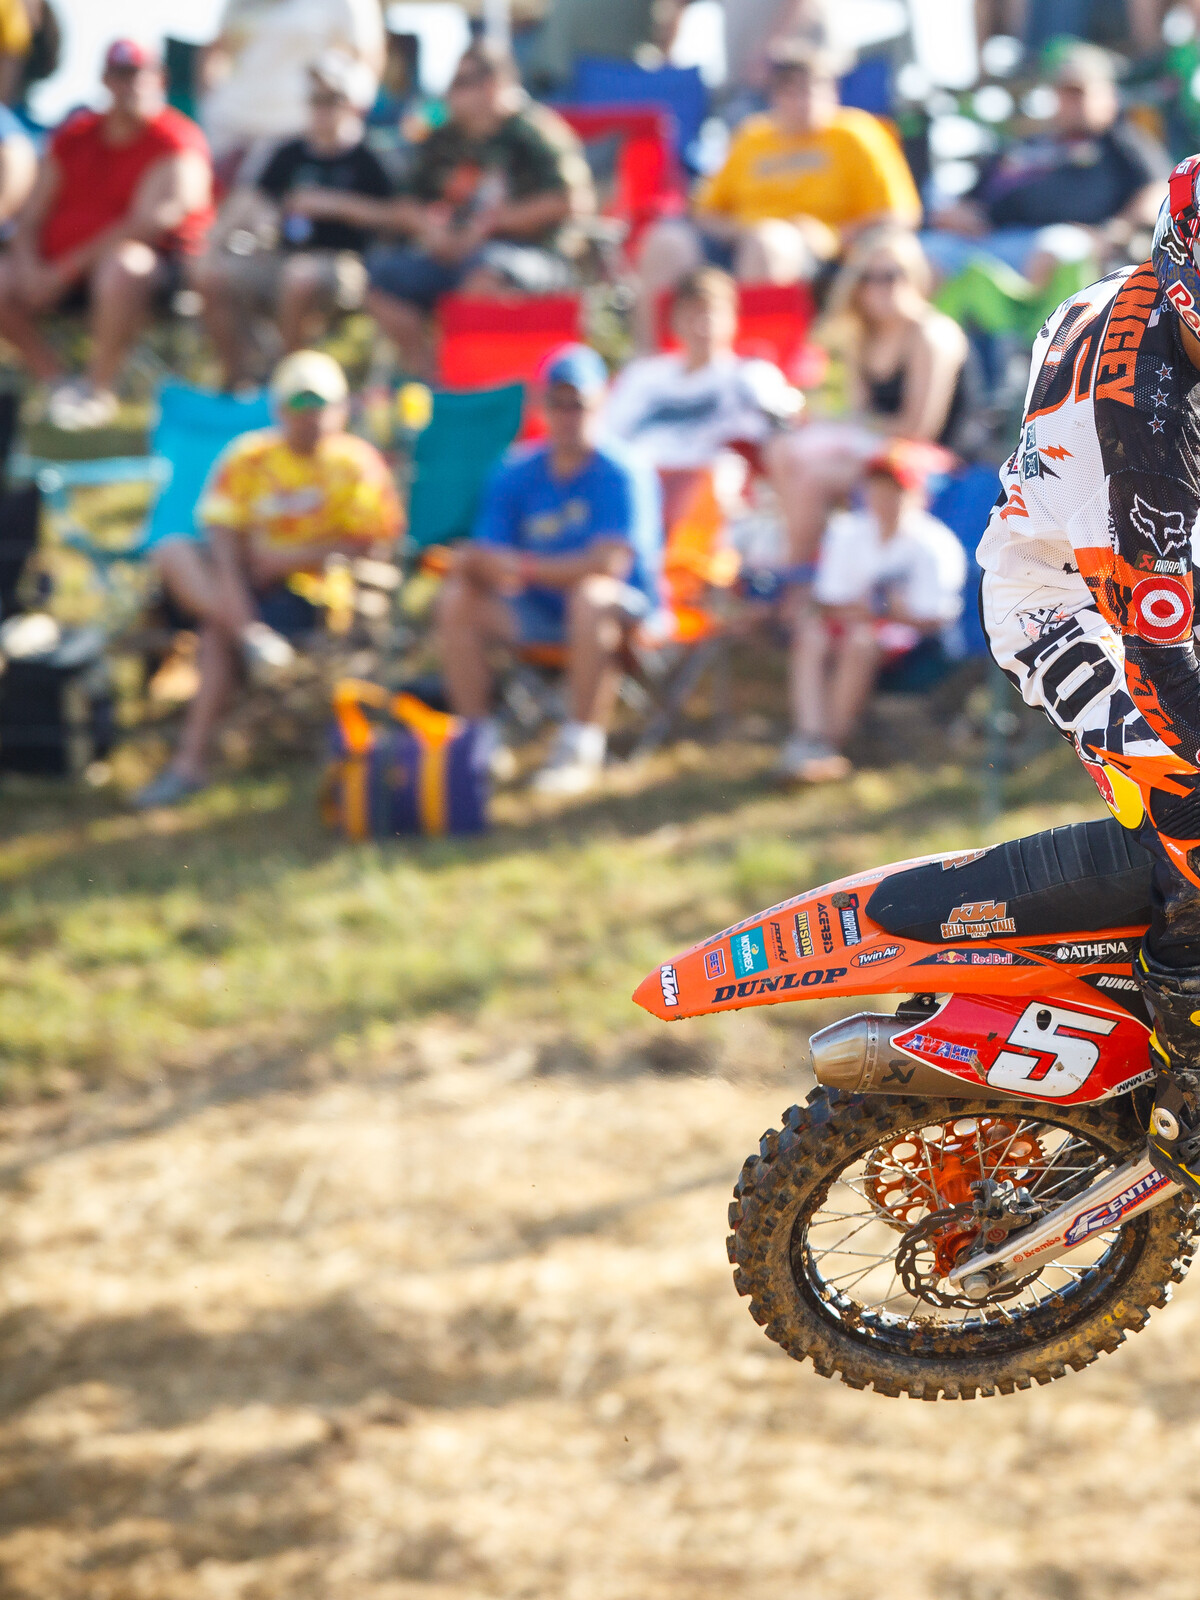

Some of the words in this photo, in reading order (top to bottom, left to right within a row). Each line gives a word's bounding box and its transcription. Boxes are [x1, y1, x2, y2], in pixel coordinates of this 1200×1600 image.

[1096, 257, 1159, 408] UNGEY
[1166, 842, 1184, 857] FOX
[948, 900, 1007, 924] KTM
[798, 912, 813, 956] HINSON
[941, 922, 965, 939] SELLE
[966, 923, 991, 936] DALLA
[991, 917, 1016, 932] VALLE
[740, 934, 754, 972] MOTOREX
[859, 949, 881, 965] Twin
[884, 945, 899, 957] Air
[971, 953, 992, 964] Red
[993, 954, 1012, 965] Bull
[1070, 942, 1128, 959] ATHENA
[709, 953, 720, 974] GET
[660, 964, 679, 1007] KTM
[711, 967, 847, 1003] DUNLOP
[903, 1033, 951, 1058] AMA
[951, 1044, 978, 1058] PRO
[986, 1001, 1120, 1098] 5
[1024, 1236, 1061, 1258] brembo
